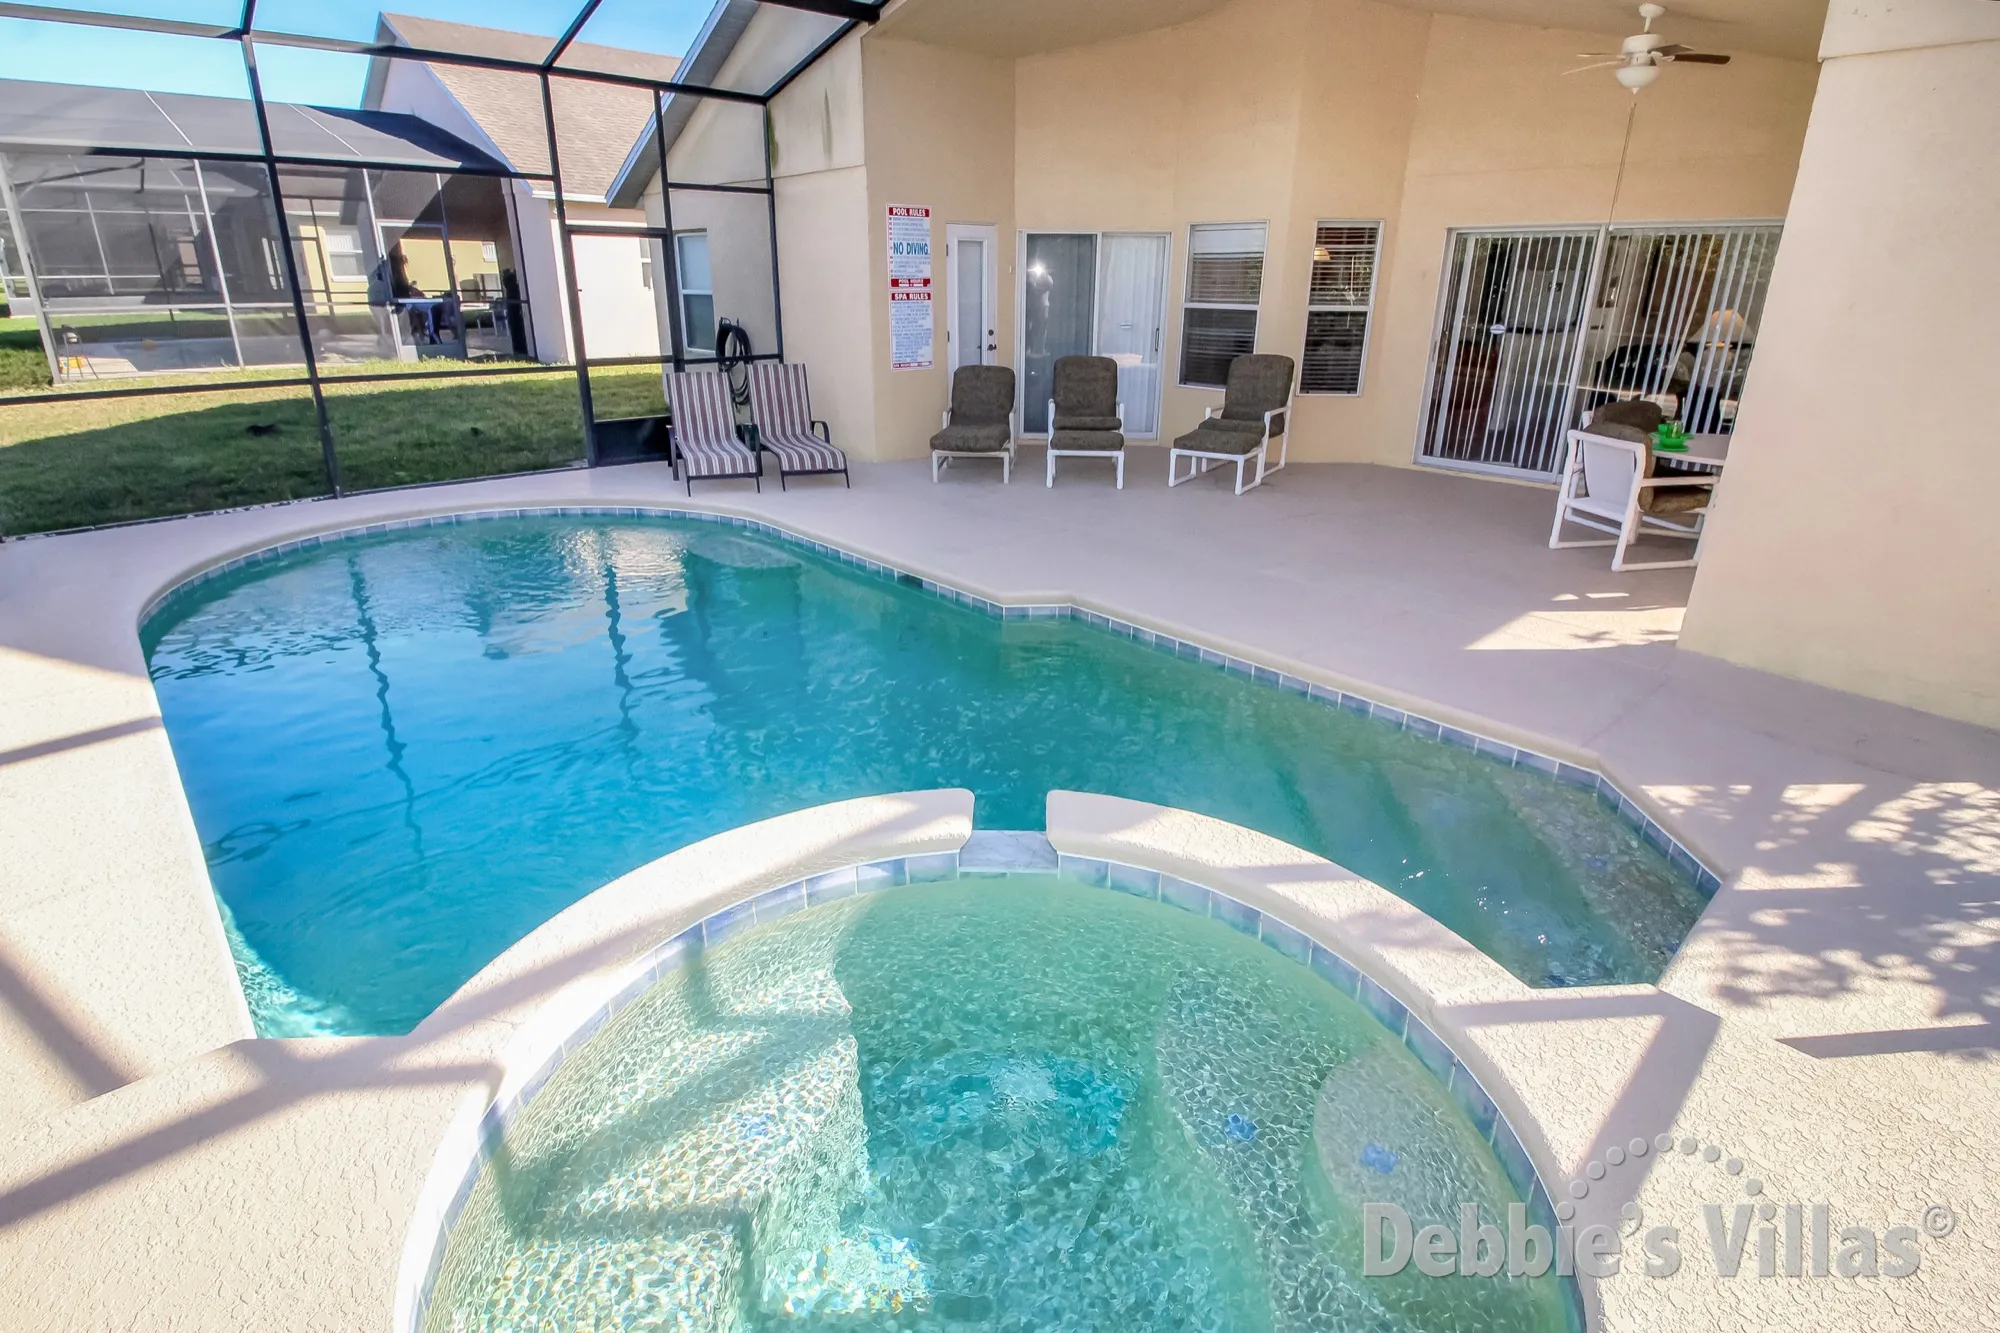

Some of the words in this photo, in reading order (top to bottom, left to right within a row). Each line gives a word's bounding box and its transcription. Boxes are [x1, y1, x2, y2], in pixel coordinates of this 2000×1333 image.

[893, 207, 908, 216] POOL
[909, 208, 926, 217] RULES
[893, 241, 904, 255] NO
[906, 242, 929, 255] DIVING
